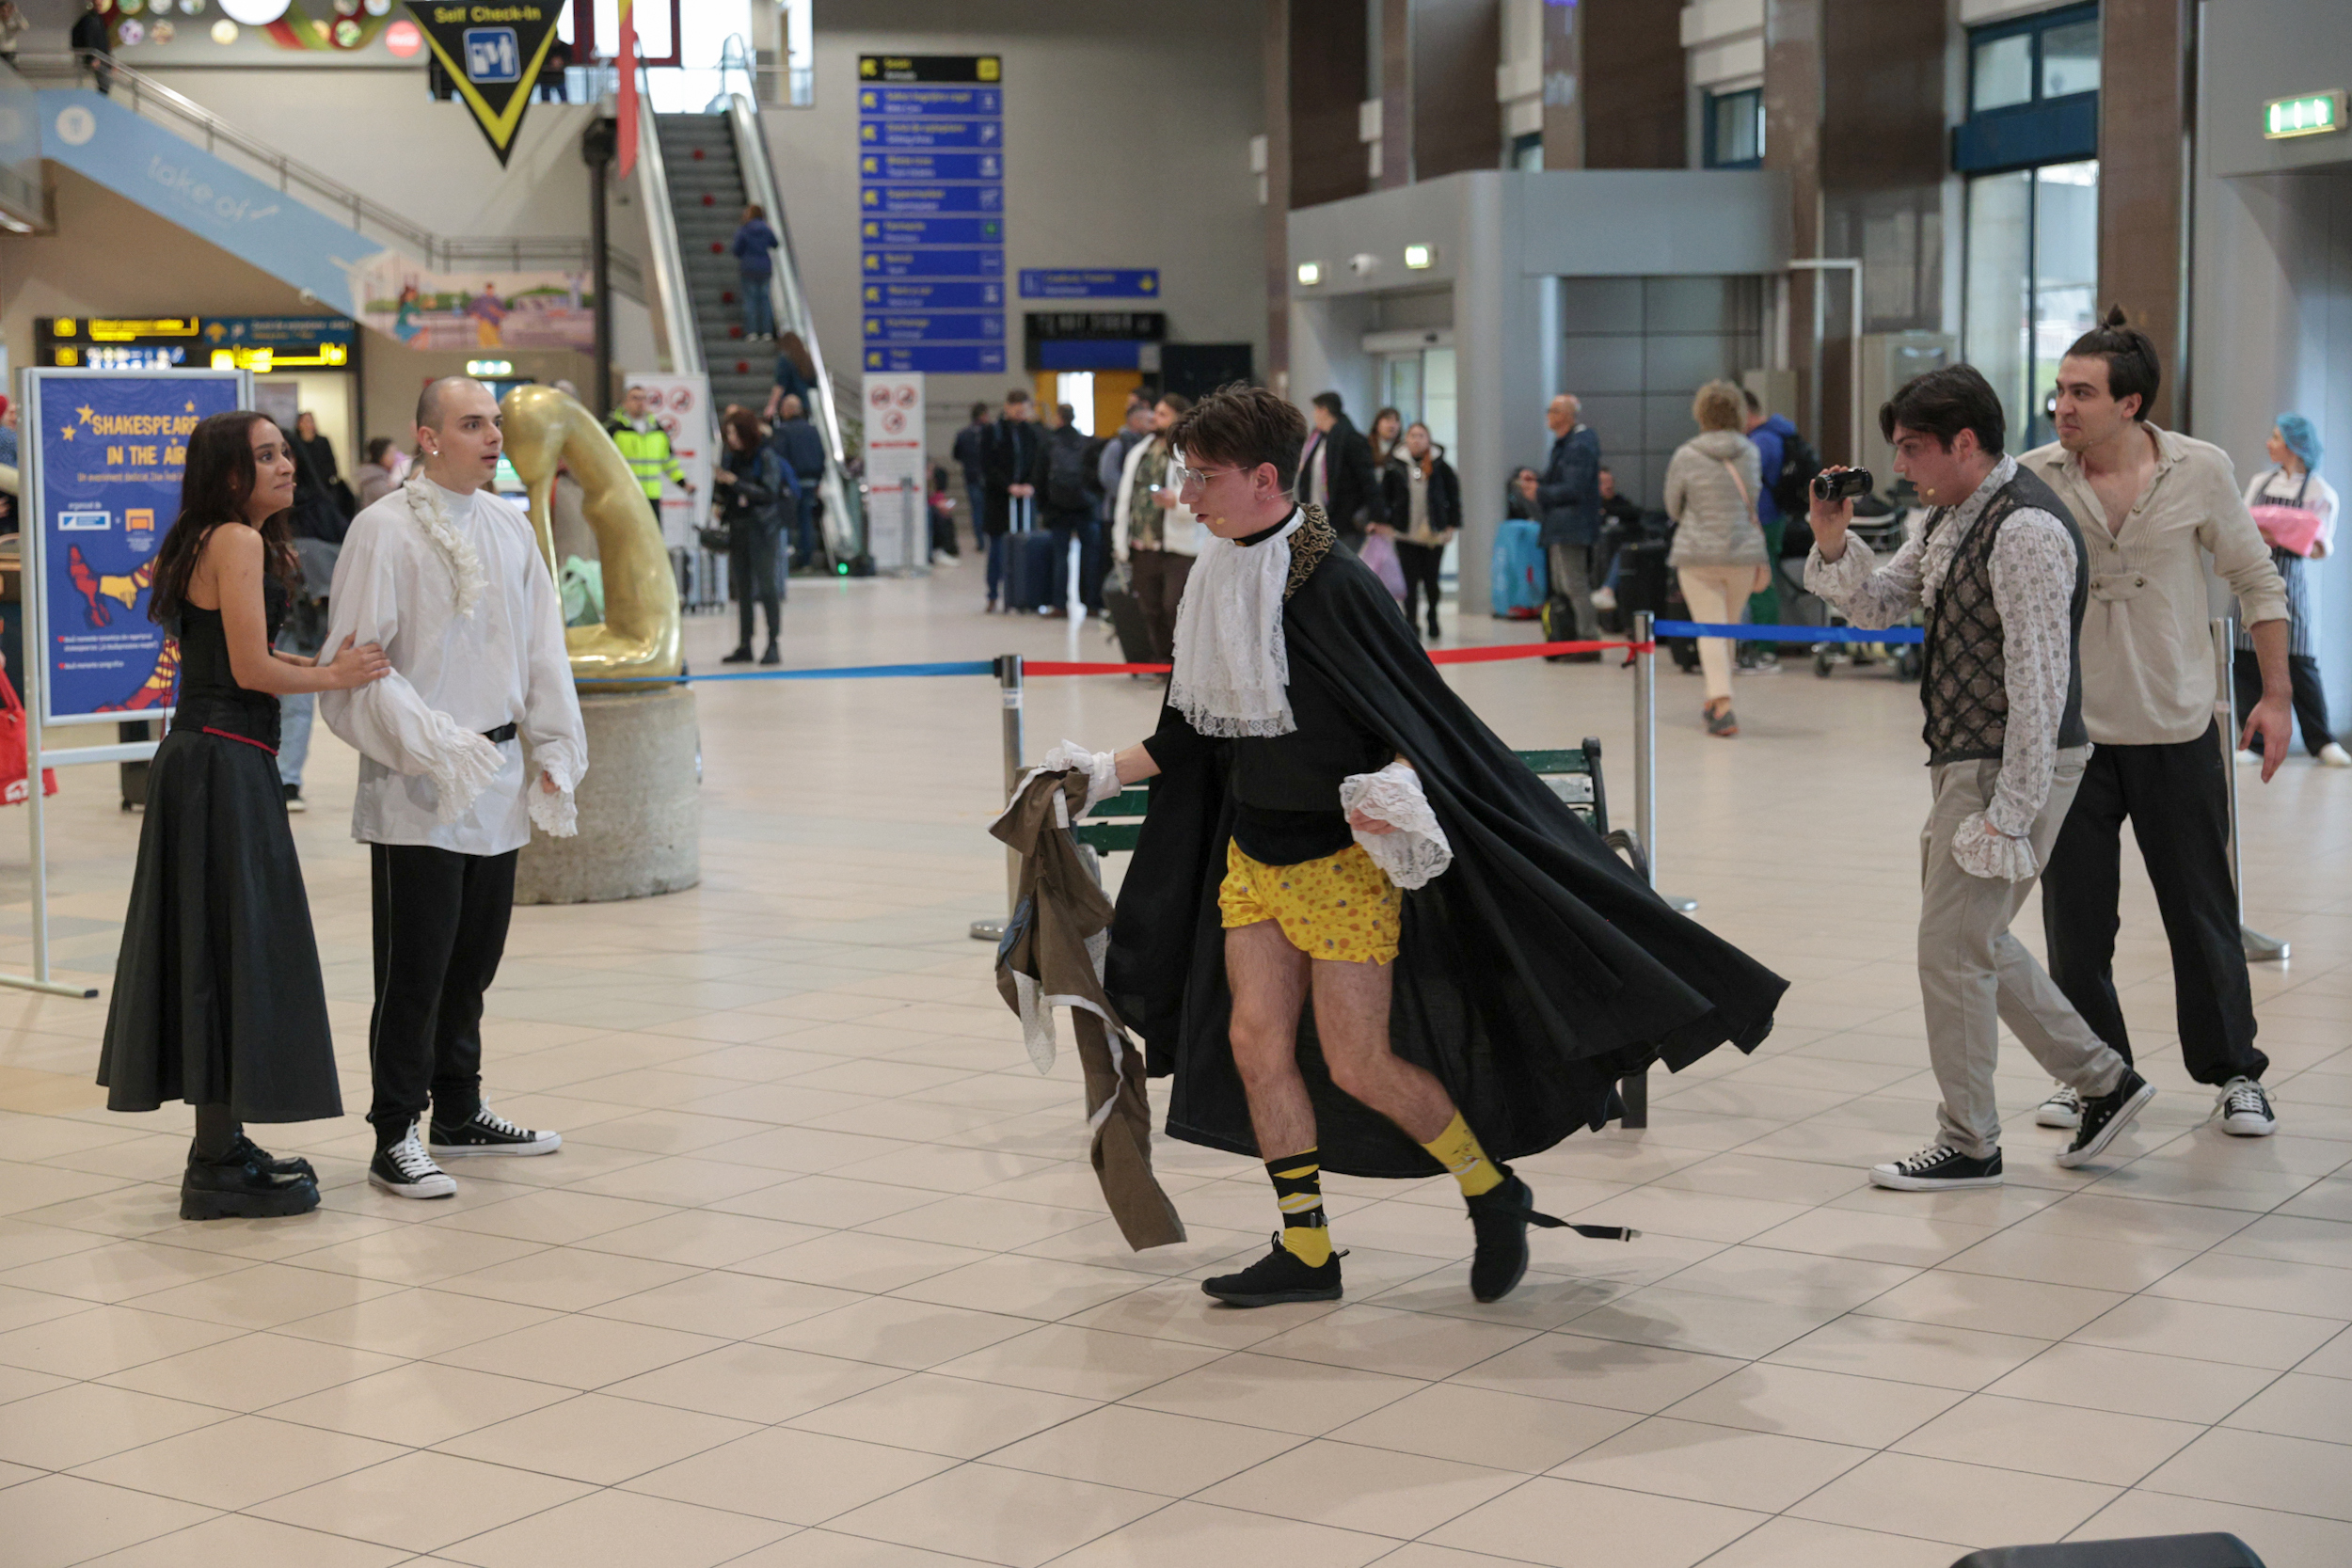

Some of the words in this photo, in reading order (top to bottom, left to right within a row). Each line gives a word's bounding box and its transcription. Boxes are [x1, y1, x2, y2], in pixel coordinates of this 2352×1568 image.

[434, 7, 467, 24] Self
[470, 6, 542, 23] Check-In
[106, 445, 124, 466] IN
[128, 445, 158, 466] THE
[163, 445, 187, 466] AIR
